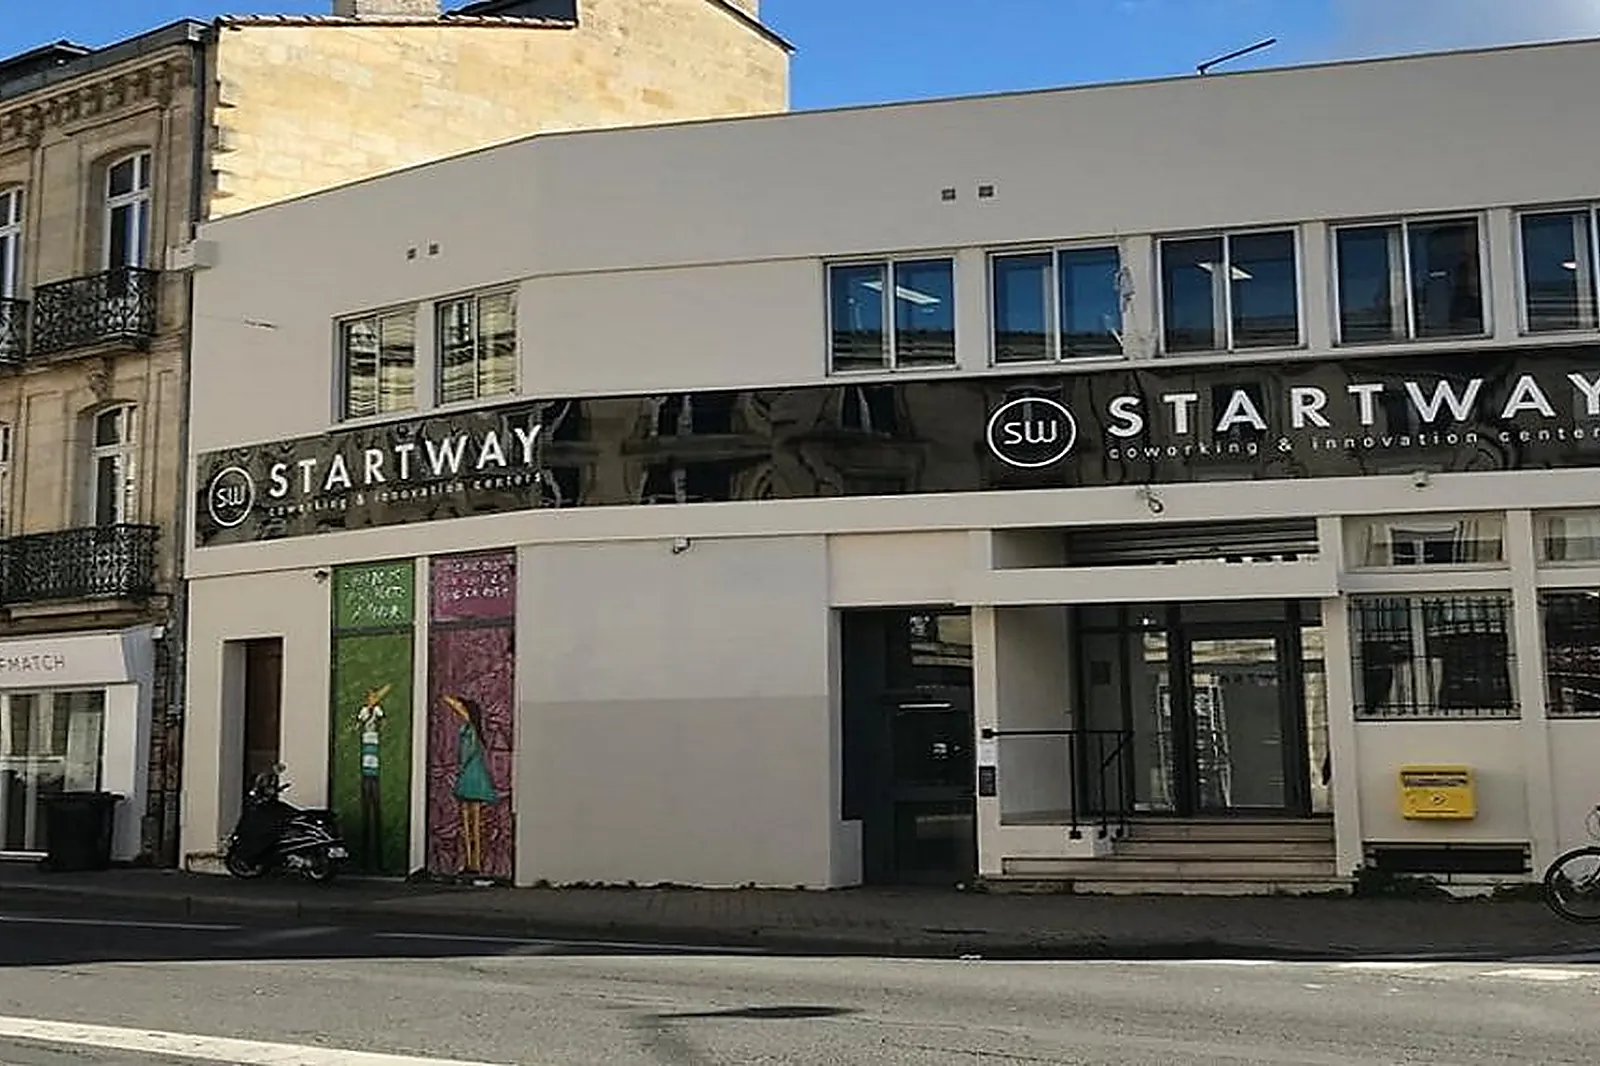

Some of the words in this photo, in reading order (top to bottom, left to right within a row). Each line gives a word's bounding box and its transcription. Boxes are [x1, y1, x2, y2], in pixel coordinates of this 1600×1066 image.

[1107, 373, 1600, 437] STARTWAY
[268, 424, 542, 498] STARTWAY
[1108, 442, 1258, 460] coworking
[1277, 438, 1292, 452] &
[1312, 432, 1478, 450] innovation
